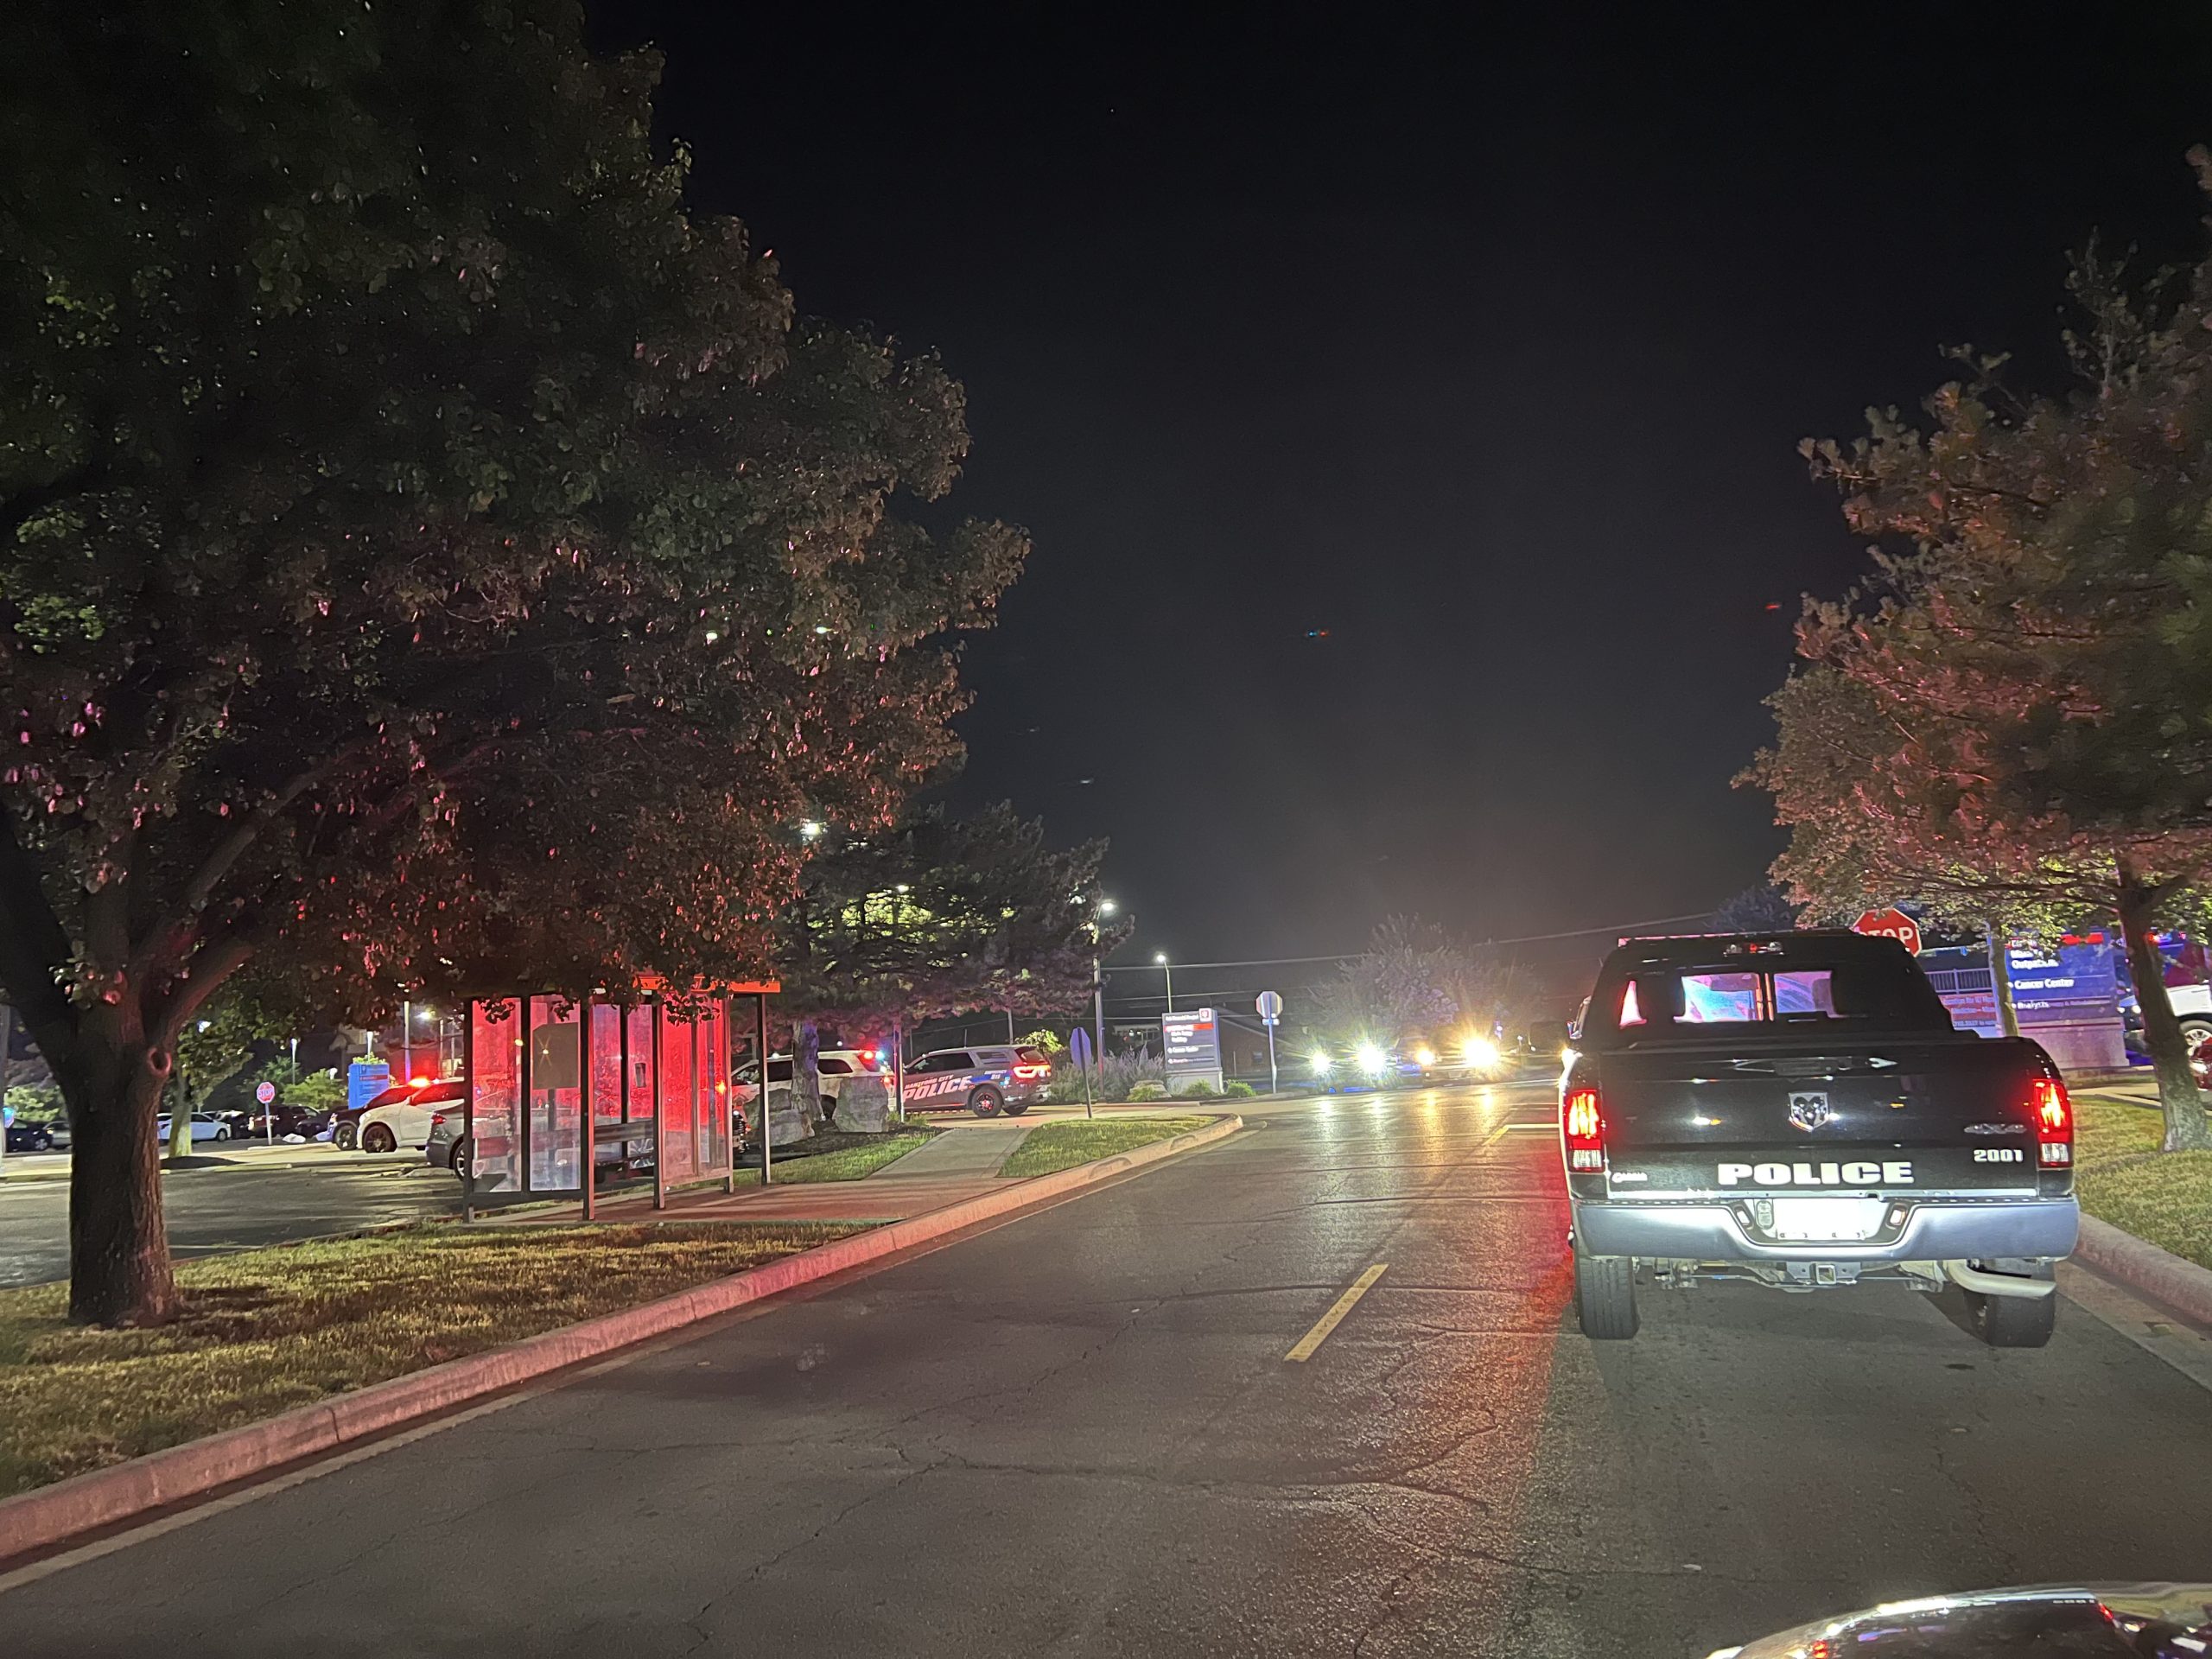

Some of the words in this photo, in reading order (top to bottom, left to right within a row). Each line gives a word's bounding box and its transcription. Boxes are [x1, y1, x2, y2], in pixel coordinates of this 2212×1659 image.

[938, 1074, 954, 1083] CITY
[903, 1075, 972, 1103] POLICE
[1974, 1149, 2024, 1162] 2001
[1718, 1161, 1915, 1185] POLICE
